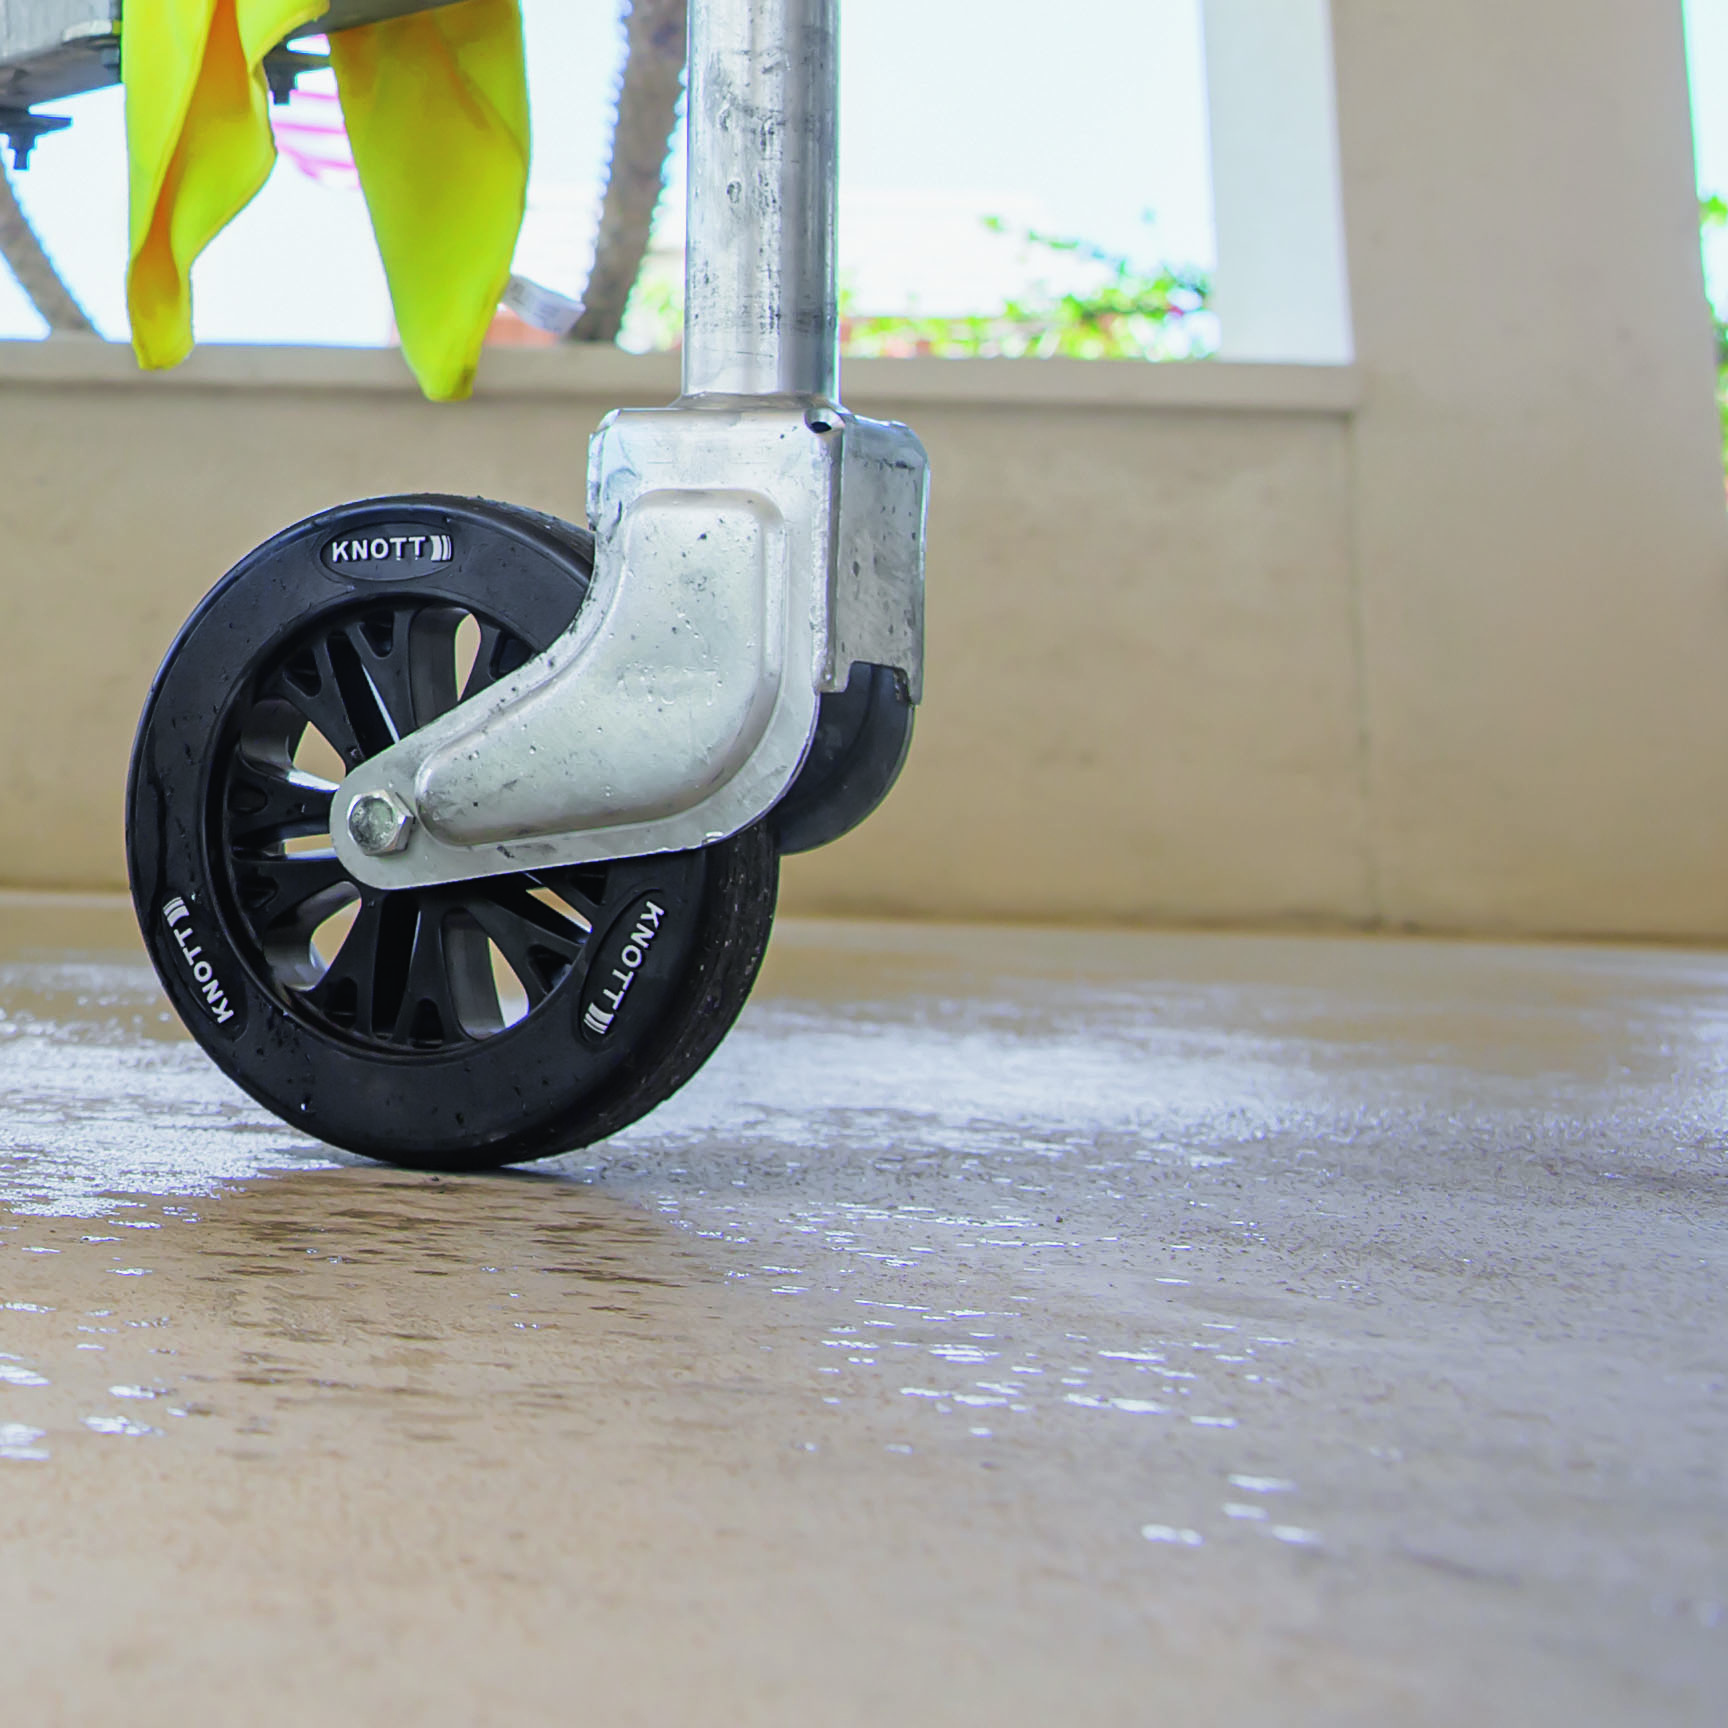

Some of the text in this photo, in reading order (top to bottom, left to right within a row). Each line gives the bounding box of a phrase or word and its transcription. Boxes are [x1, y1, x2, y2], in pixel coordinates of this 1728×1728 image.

[332, 536, 425, 562] KNOTT
[172, 921, 234, 1023] KNOTT
[605, 900, 665, 1011] KNOTT
